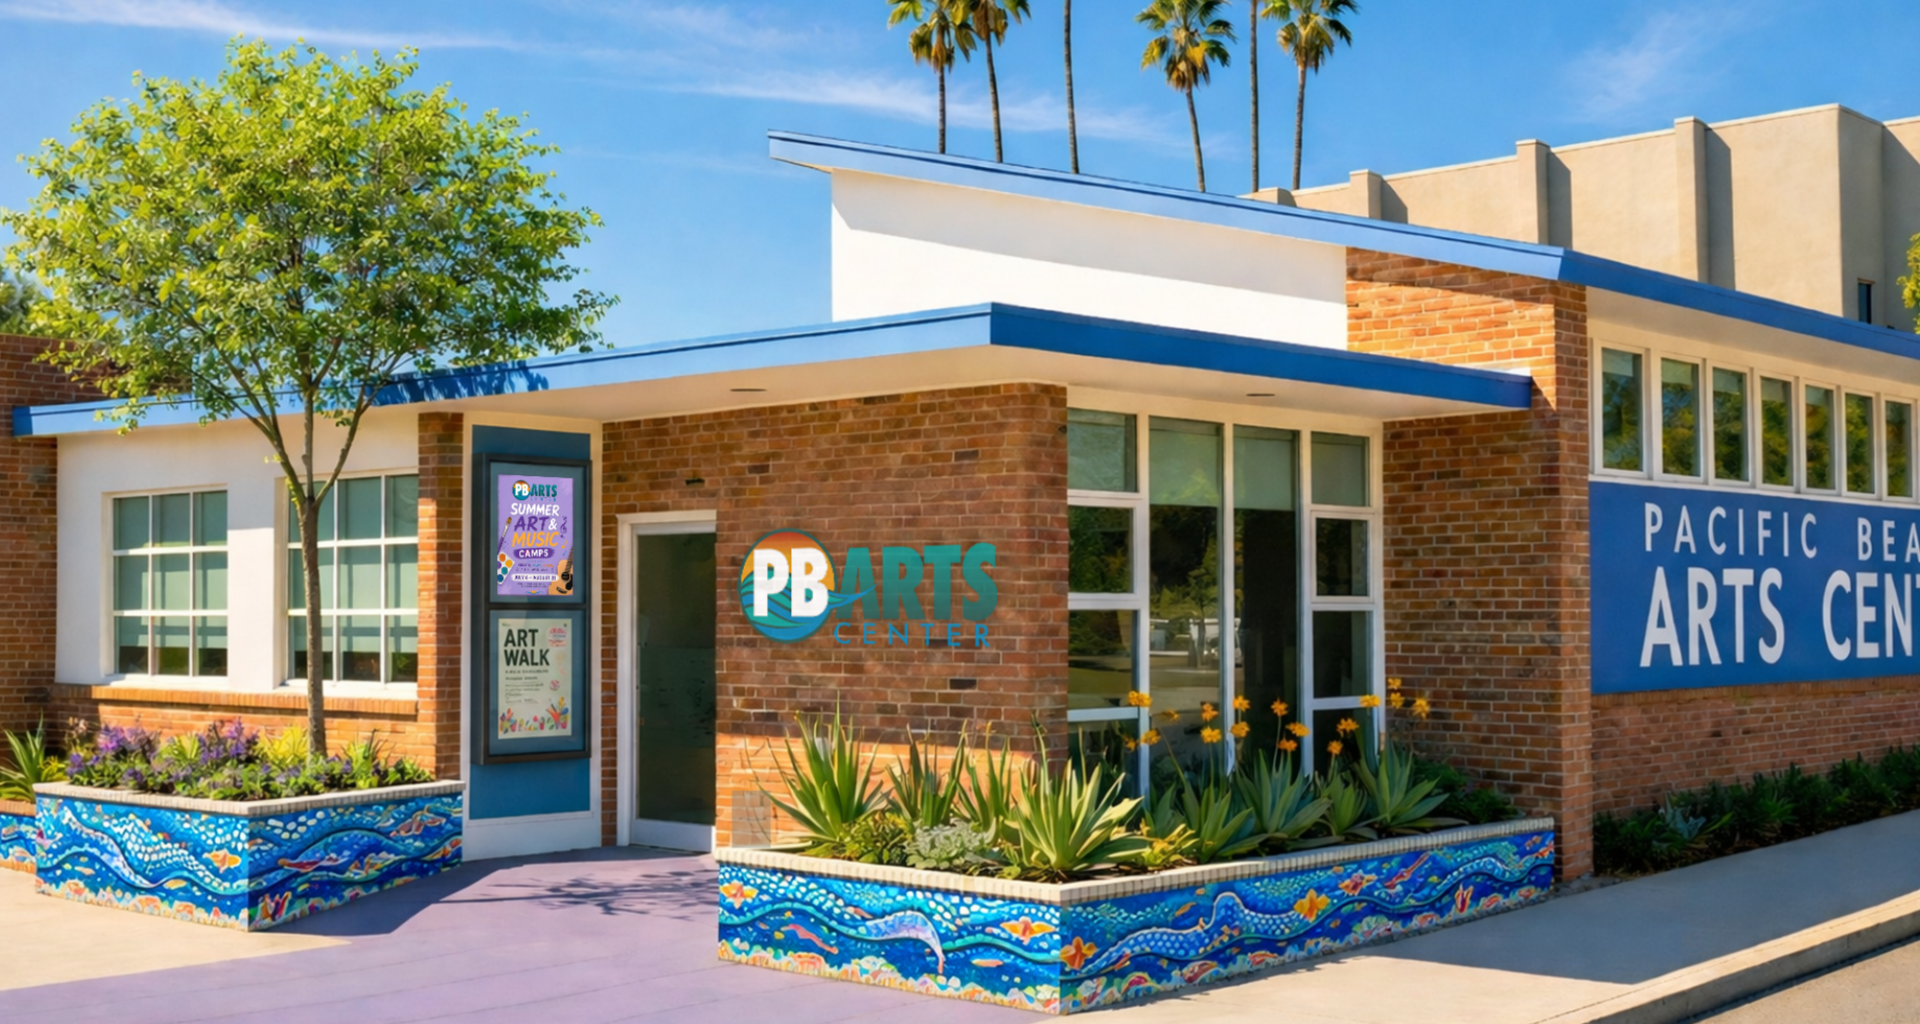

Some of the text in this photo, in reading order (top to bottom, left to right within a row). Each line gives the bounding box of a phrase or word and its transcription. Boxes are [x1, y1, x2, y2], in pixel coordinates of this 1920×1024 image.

[515, 483, 557, 497] PB ARTS
[510, 502, 560, 516] SUMMER
[513, 516, 558, 531] ART &
[1644, 502, 1817, 559] PACIFIC
[511, 531, 560, 547] MUSIC
[518, 549, 549, 558] CAMPS
[753, 542, 998, 621] PB ARTS
[1639, 566, 1920, 667] ARTS CEN
[503, 628, 539, 647] ART
[833, 622, 991, 647] CENTER
[503, 649, 550, 666] WALK
